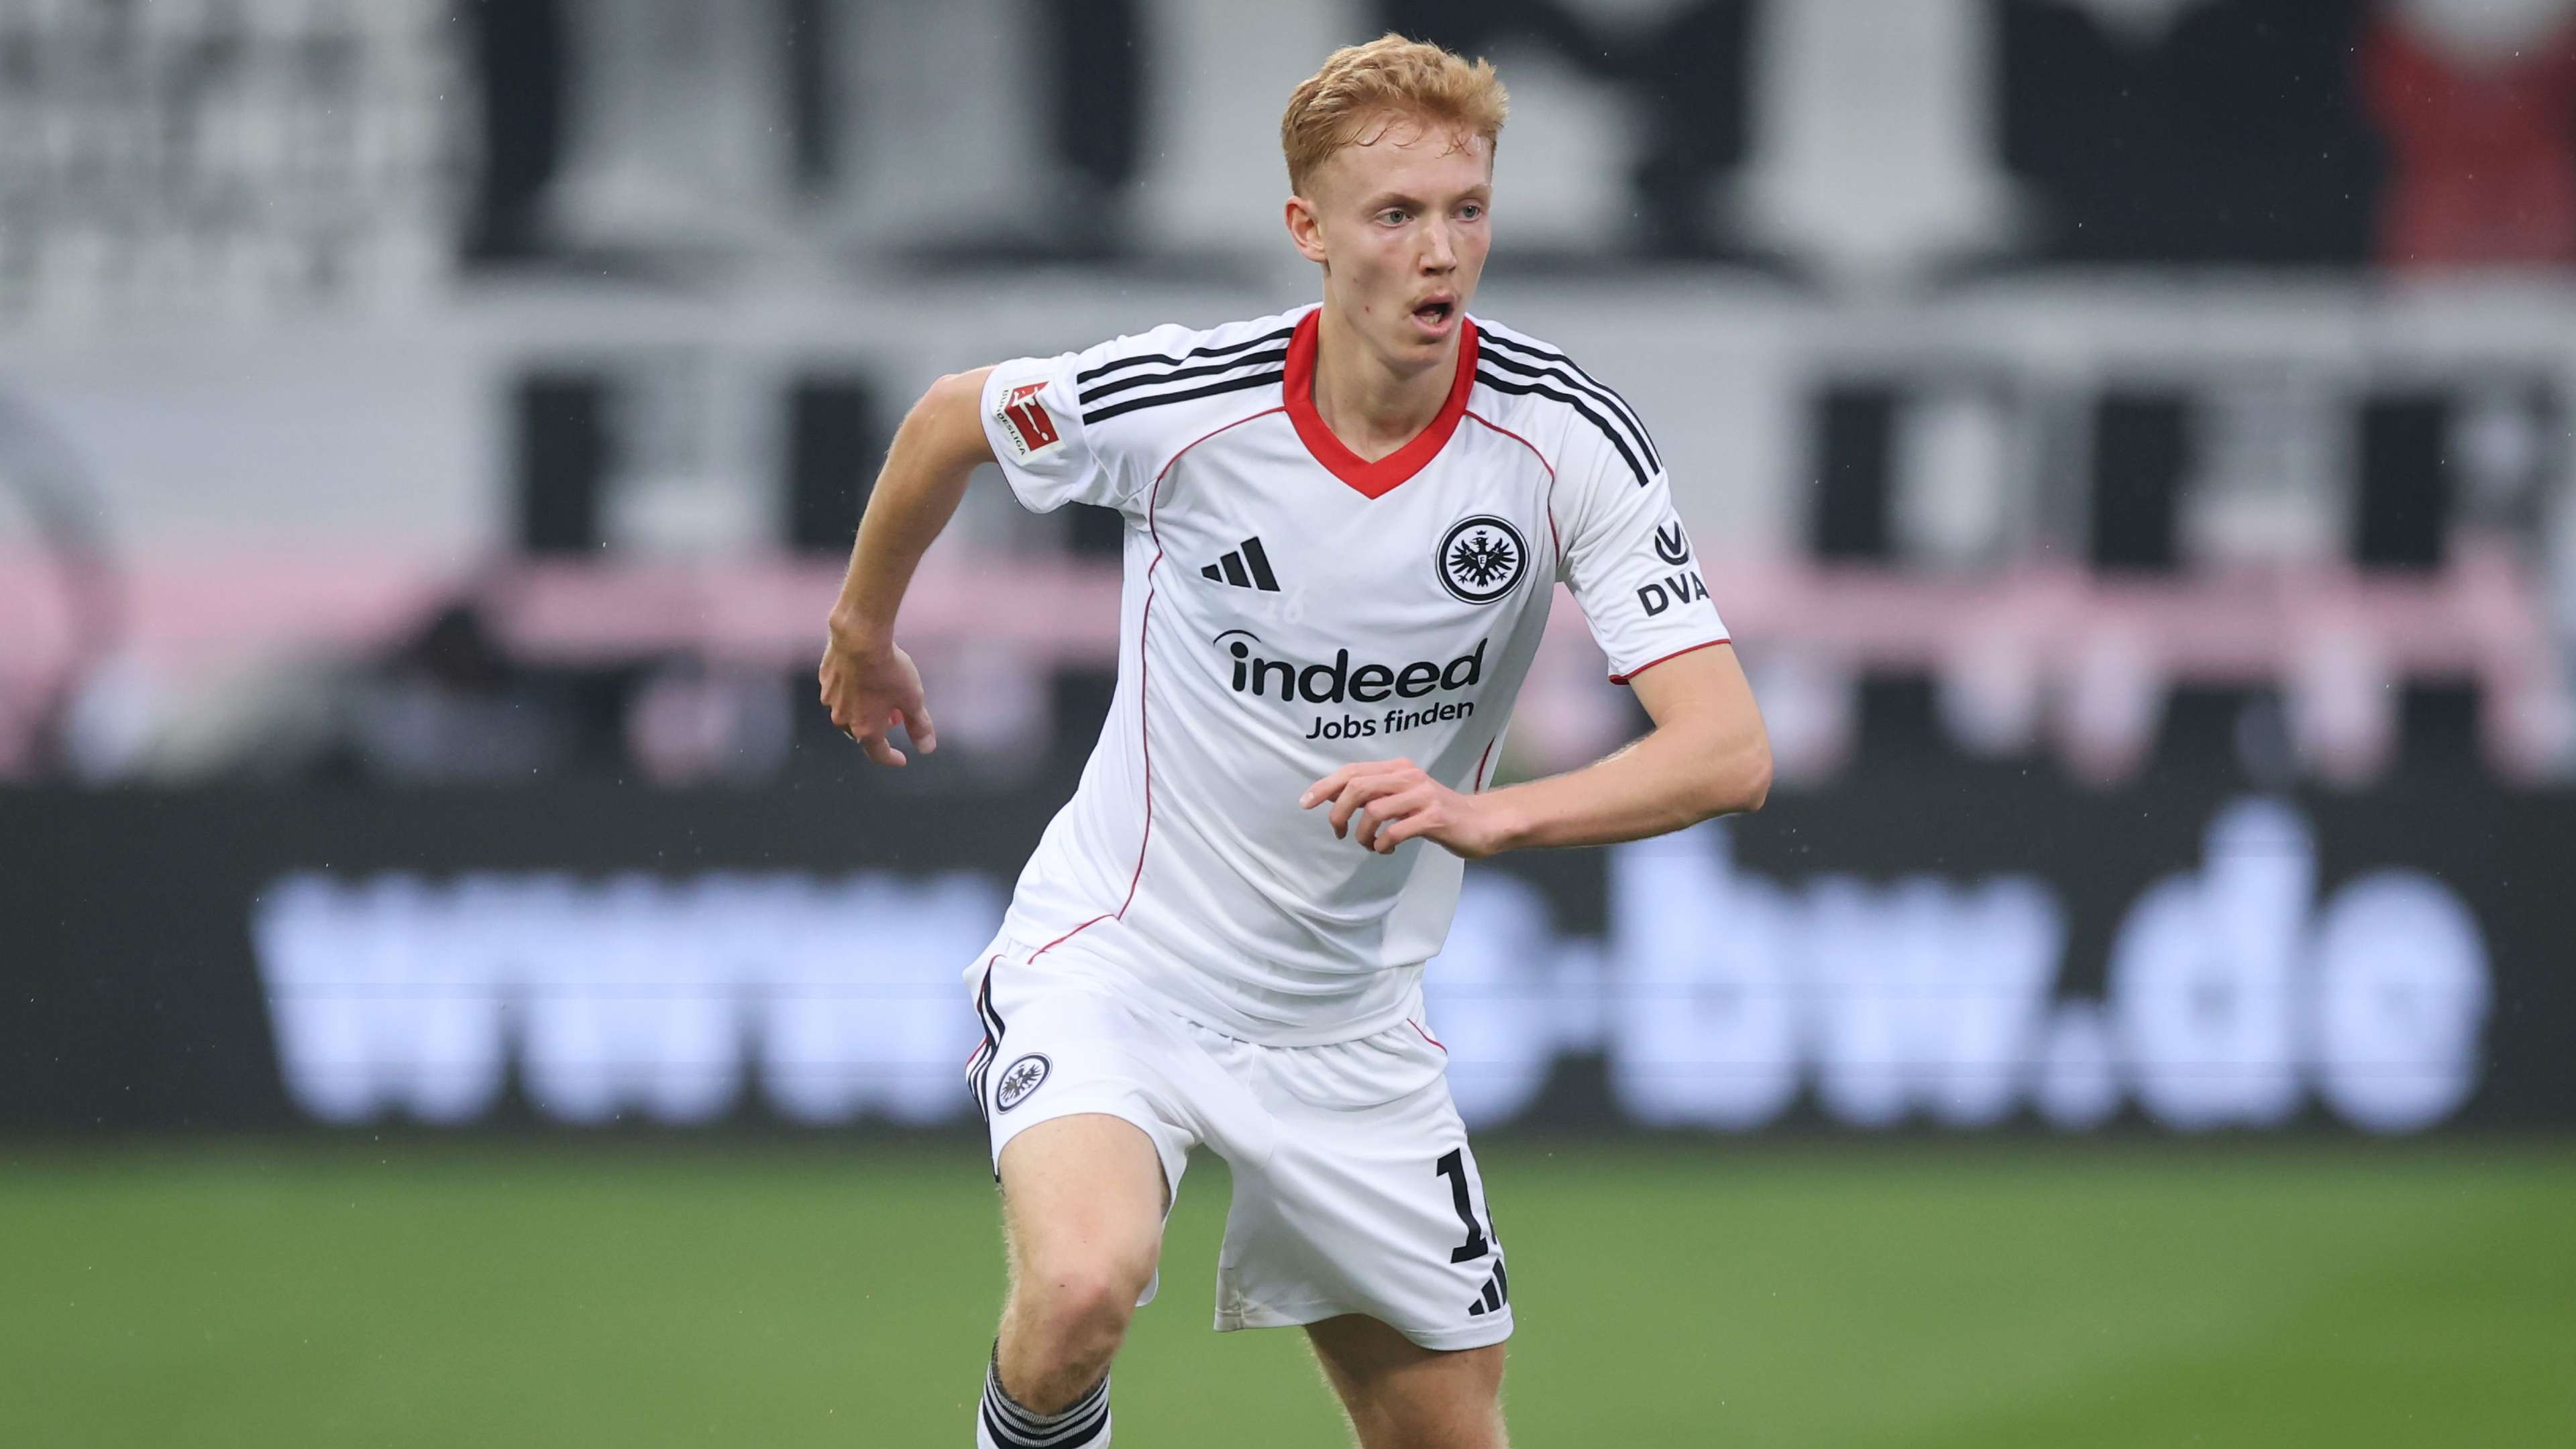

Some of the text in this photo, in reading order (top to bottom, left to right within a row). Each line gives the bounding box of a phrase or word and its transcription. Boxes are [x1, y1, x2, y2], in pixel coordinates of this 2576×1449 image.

[1230, 638, 1488, 704] indeed
[1306, 702, 1474, 739] Jobs finden
[1436, 1148, 1497, 1264] 1
